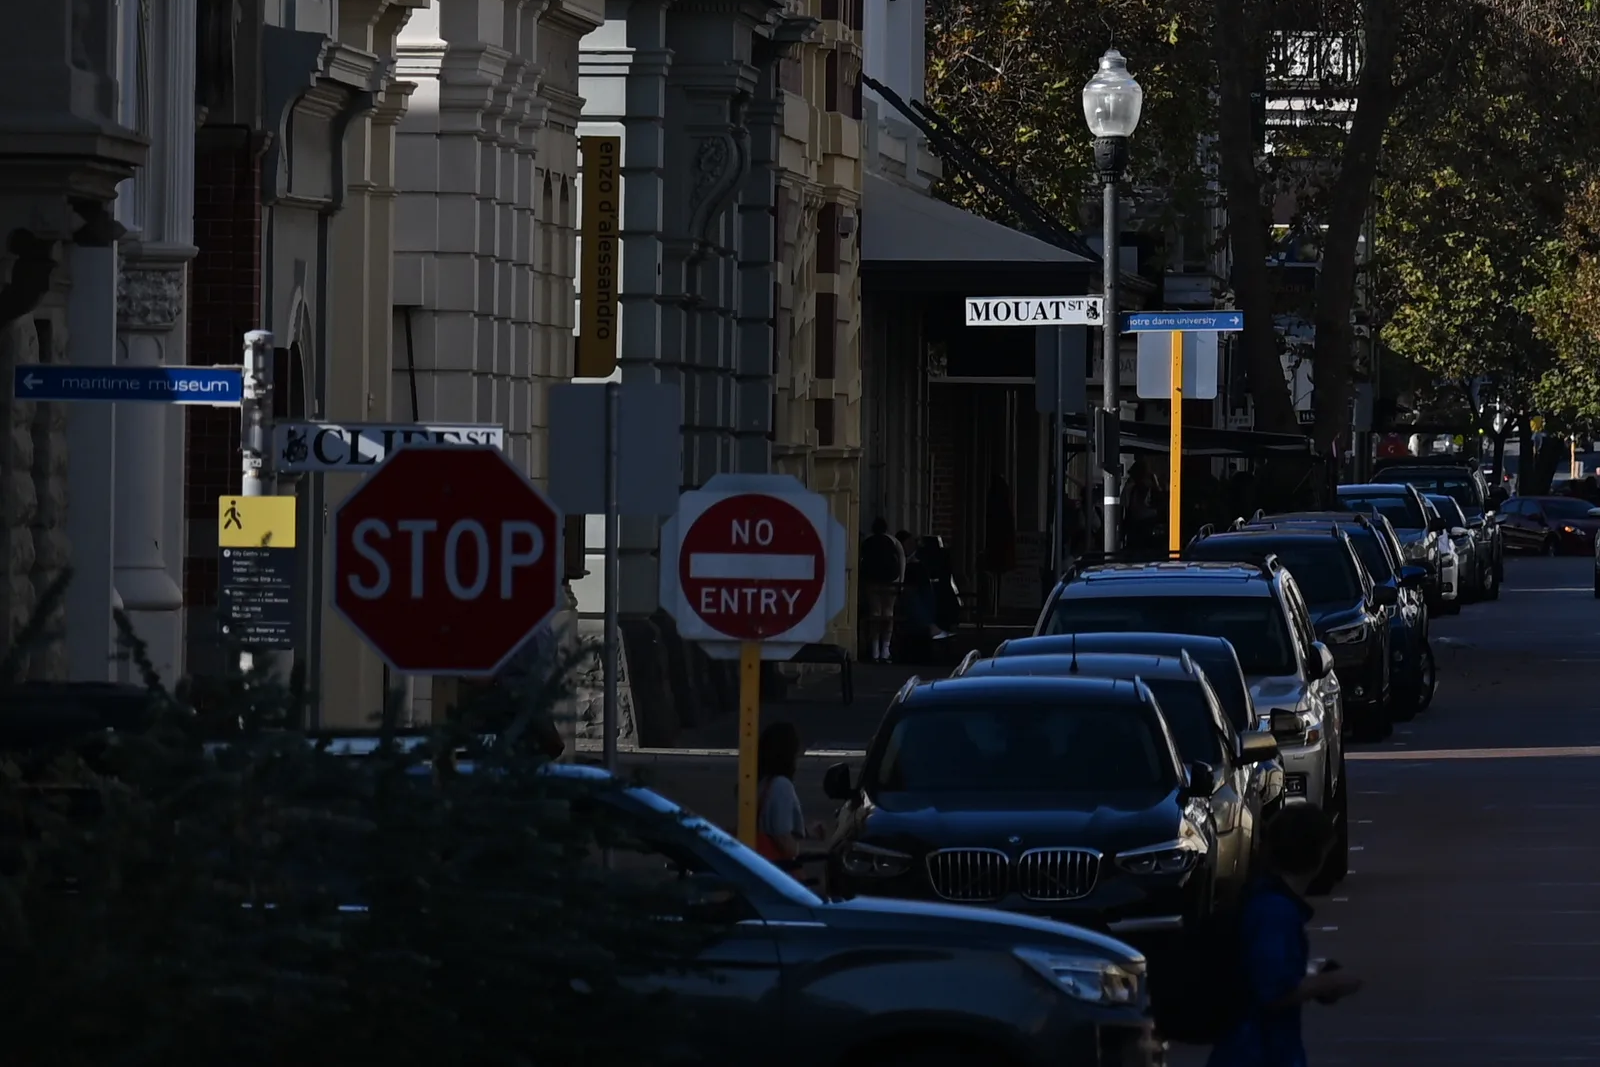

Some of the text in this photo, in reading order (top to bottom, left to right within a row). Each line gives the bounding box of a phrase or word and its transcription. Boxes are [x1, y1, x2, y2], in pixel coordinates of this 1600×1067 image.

[596, 141, 617, 340] enzo d'alessandro
[969, 300, 1084, 322] MOUAT ST
[1152, 317, 1175, 325] dame
[1177, 317, 1217, 327] university
[61, 376, 229, 392] maritime museum
[731, 519, 775, 547] NO
[347, 517, 545, 602] STOP
[700, 588, 801, 615] ENTRY
